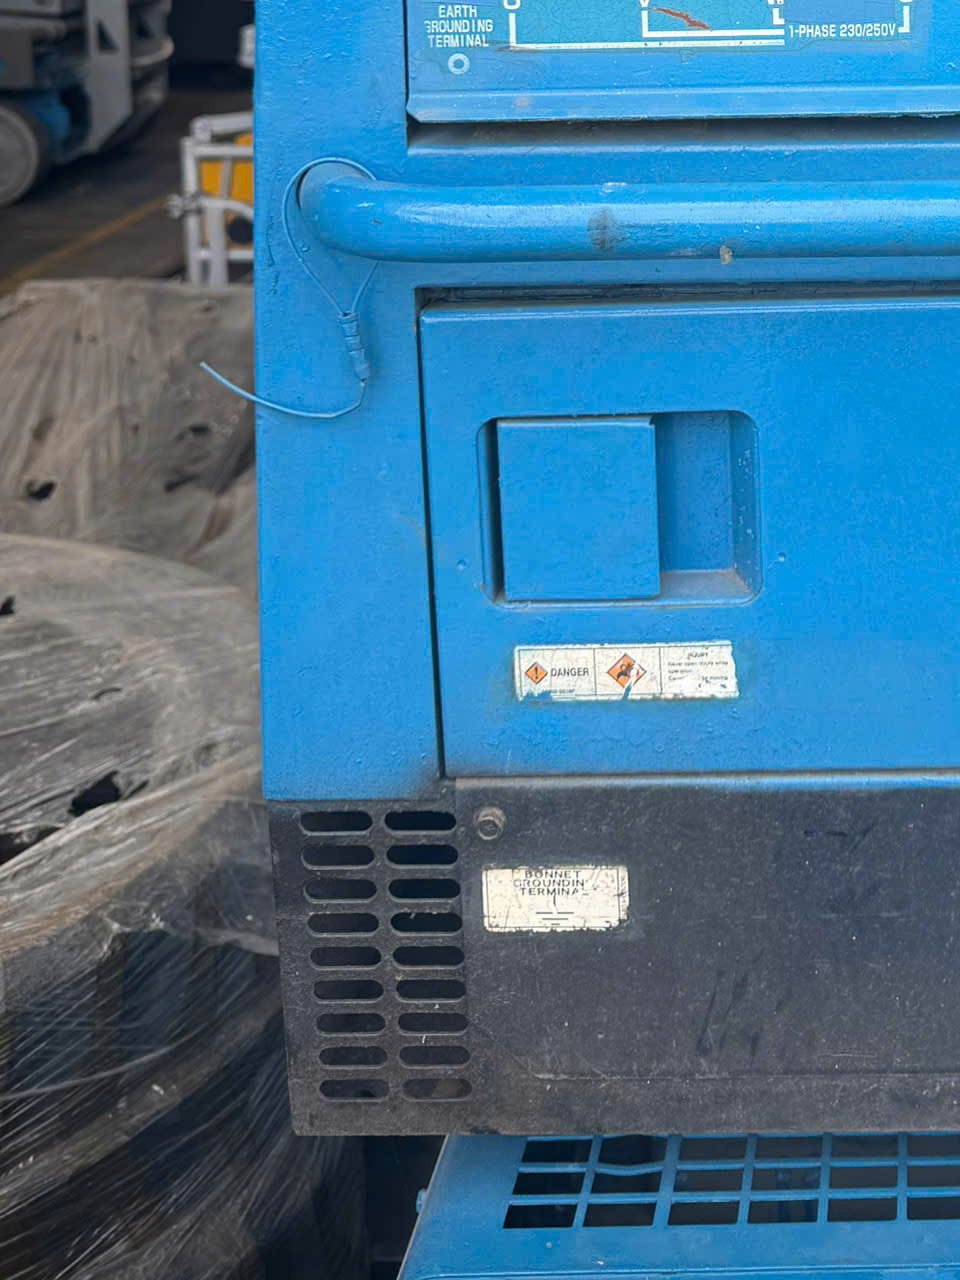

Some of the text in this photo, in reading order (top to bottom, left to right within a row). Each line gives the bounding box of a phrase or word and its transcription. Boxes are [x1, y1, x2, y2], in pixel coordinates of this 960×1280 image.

[438, 5, 478, 18] EARTH
[424, 19, 494, 33] GROUNDING
[788, 23, 896, 38] 1-PHASE 230/250V
[427, 34, 489, 48] TERMINAL
[550, 667, 589, 677] DANGER
[525, 870, 581, 879] BONNET
[513, 879, 587, 888] GROUNDIN
